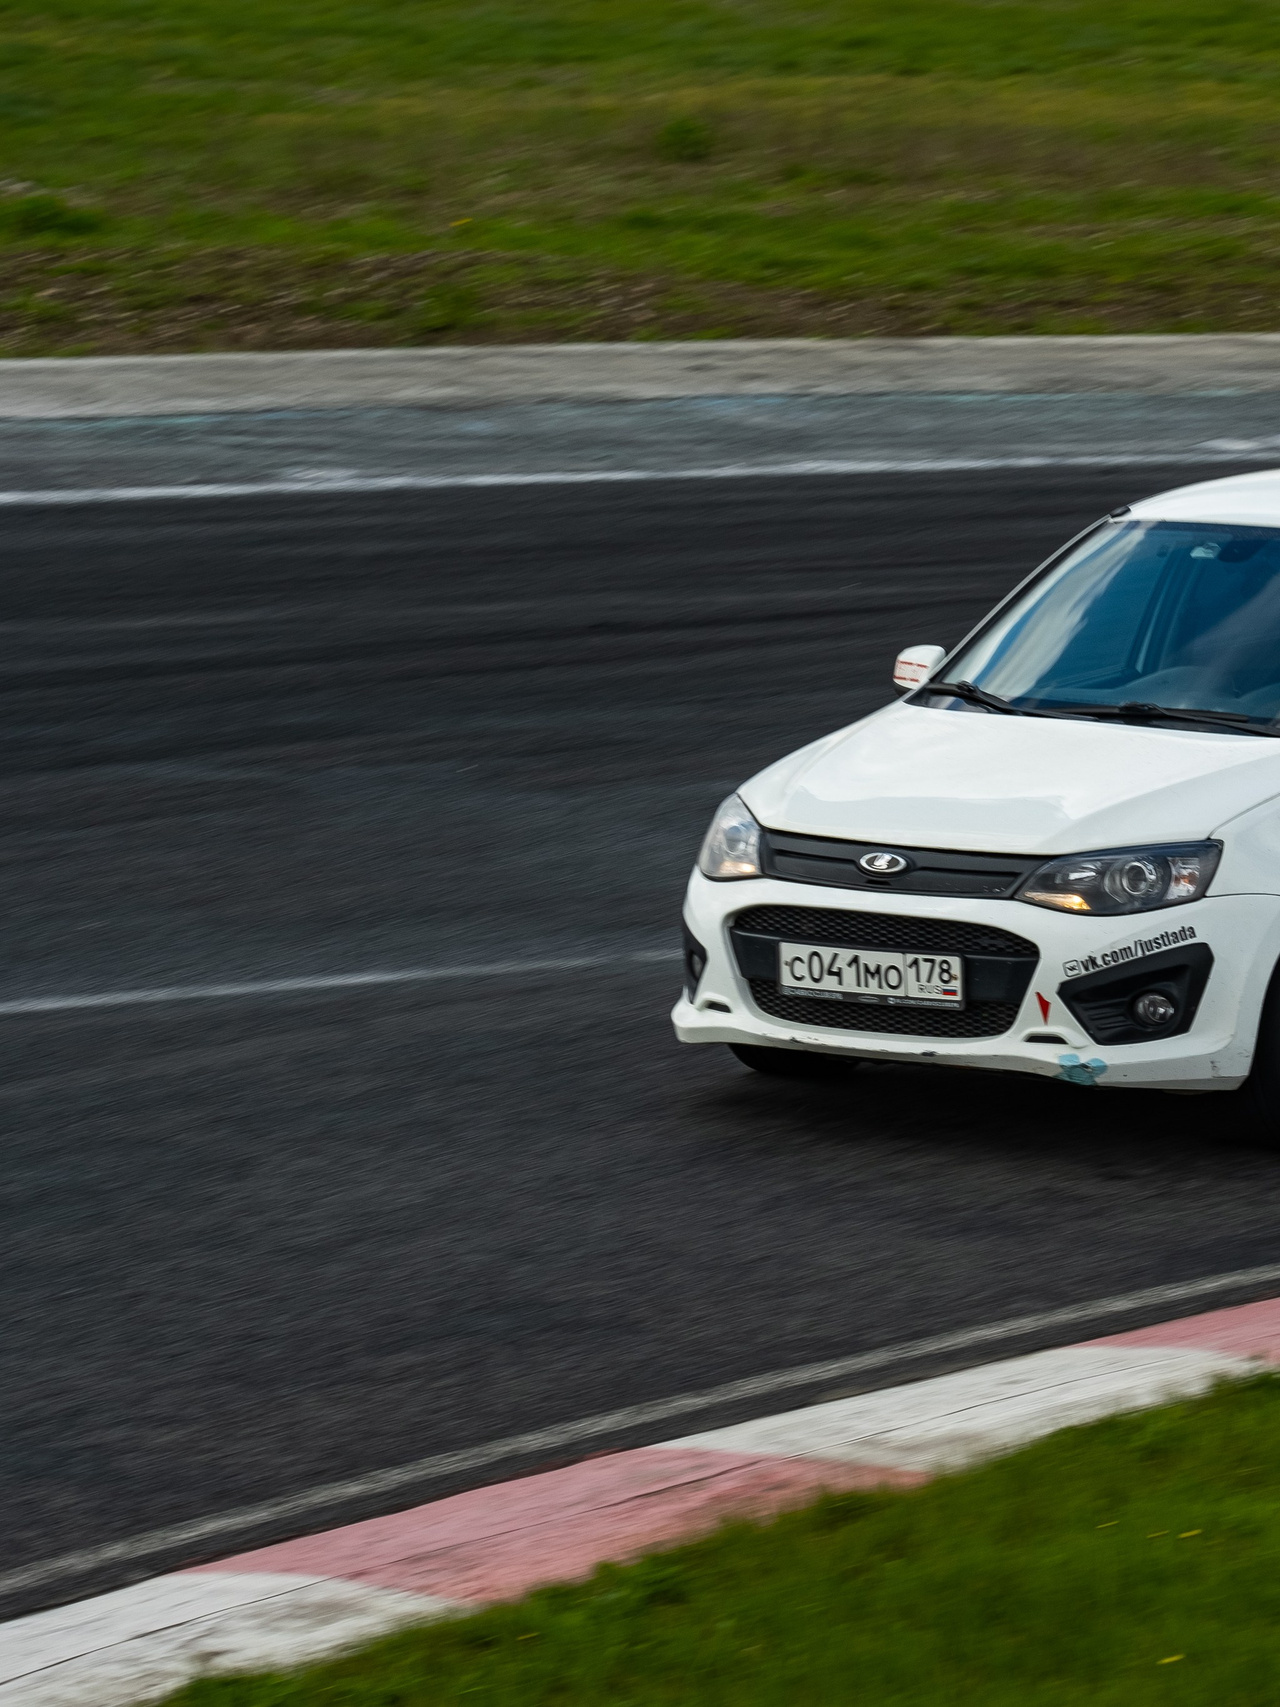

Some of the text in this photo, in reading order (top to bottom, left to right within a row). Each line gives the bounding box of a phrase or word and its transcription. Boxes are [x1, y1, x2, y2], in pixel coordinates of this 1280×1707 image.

[1080, 925, 1197, 973] vk.com/justlada
[907, 957, 952, 985] 178
[918, 984, 942, 994] RUS
